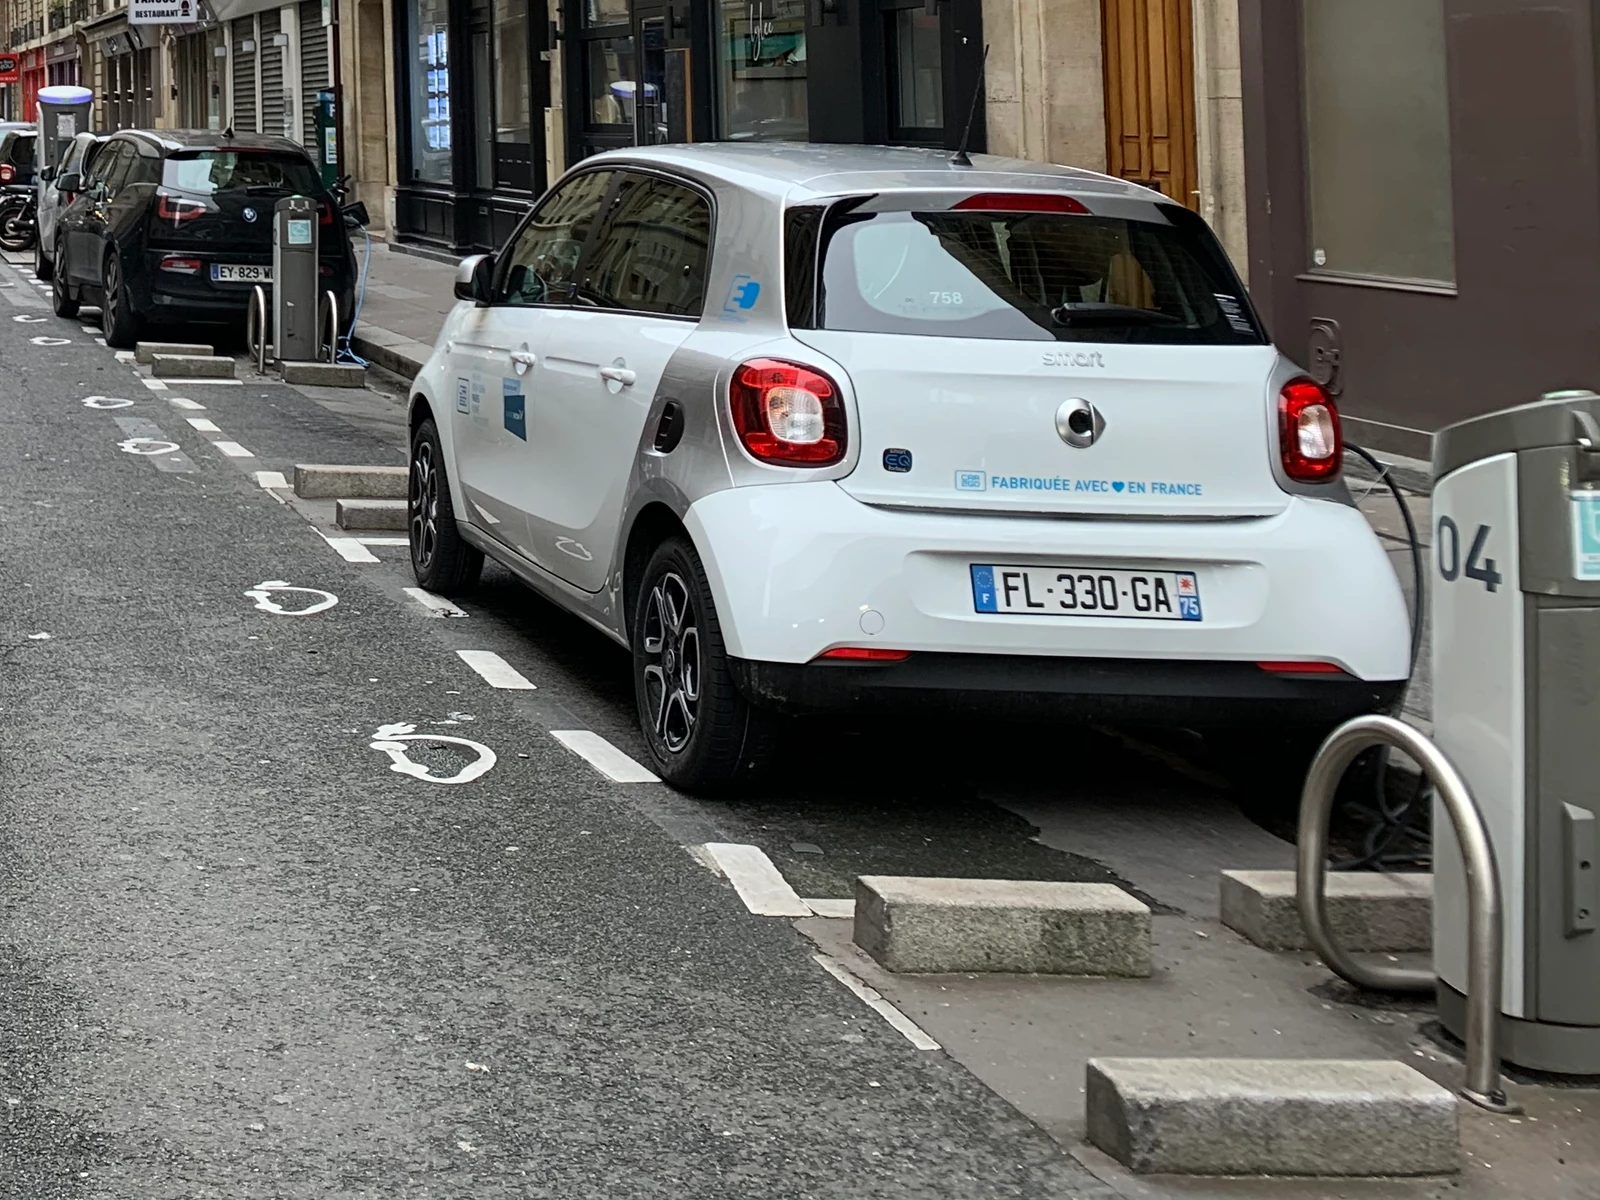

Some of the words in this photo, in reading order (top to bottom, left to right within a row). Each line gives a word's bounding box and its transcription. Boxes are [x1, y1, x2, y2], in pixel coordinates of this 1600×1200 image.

[135, 9, 179, 18] RESTAURANT
[219, 266, 274, 279] EY-829-W
[929, 291, 964, 305] 758
[1041, 350, 1106, 368] smart
[991, 475, 1070, 492] FABRIQUÉE
[1074, 479, 1109, 493] AVEC
[1128, 482, 1146, 494] EN
[1151, 482, 1202, 496] FRANCE
[1437, 515, 1503, 593] 04
[982, 593, 990, 604] F
[1002, 571, 1173, 613] FL-330-GA
[1180, 597, 1200, 616] 75
